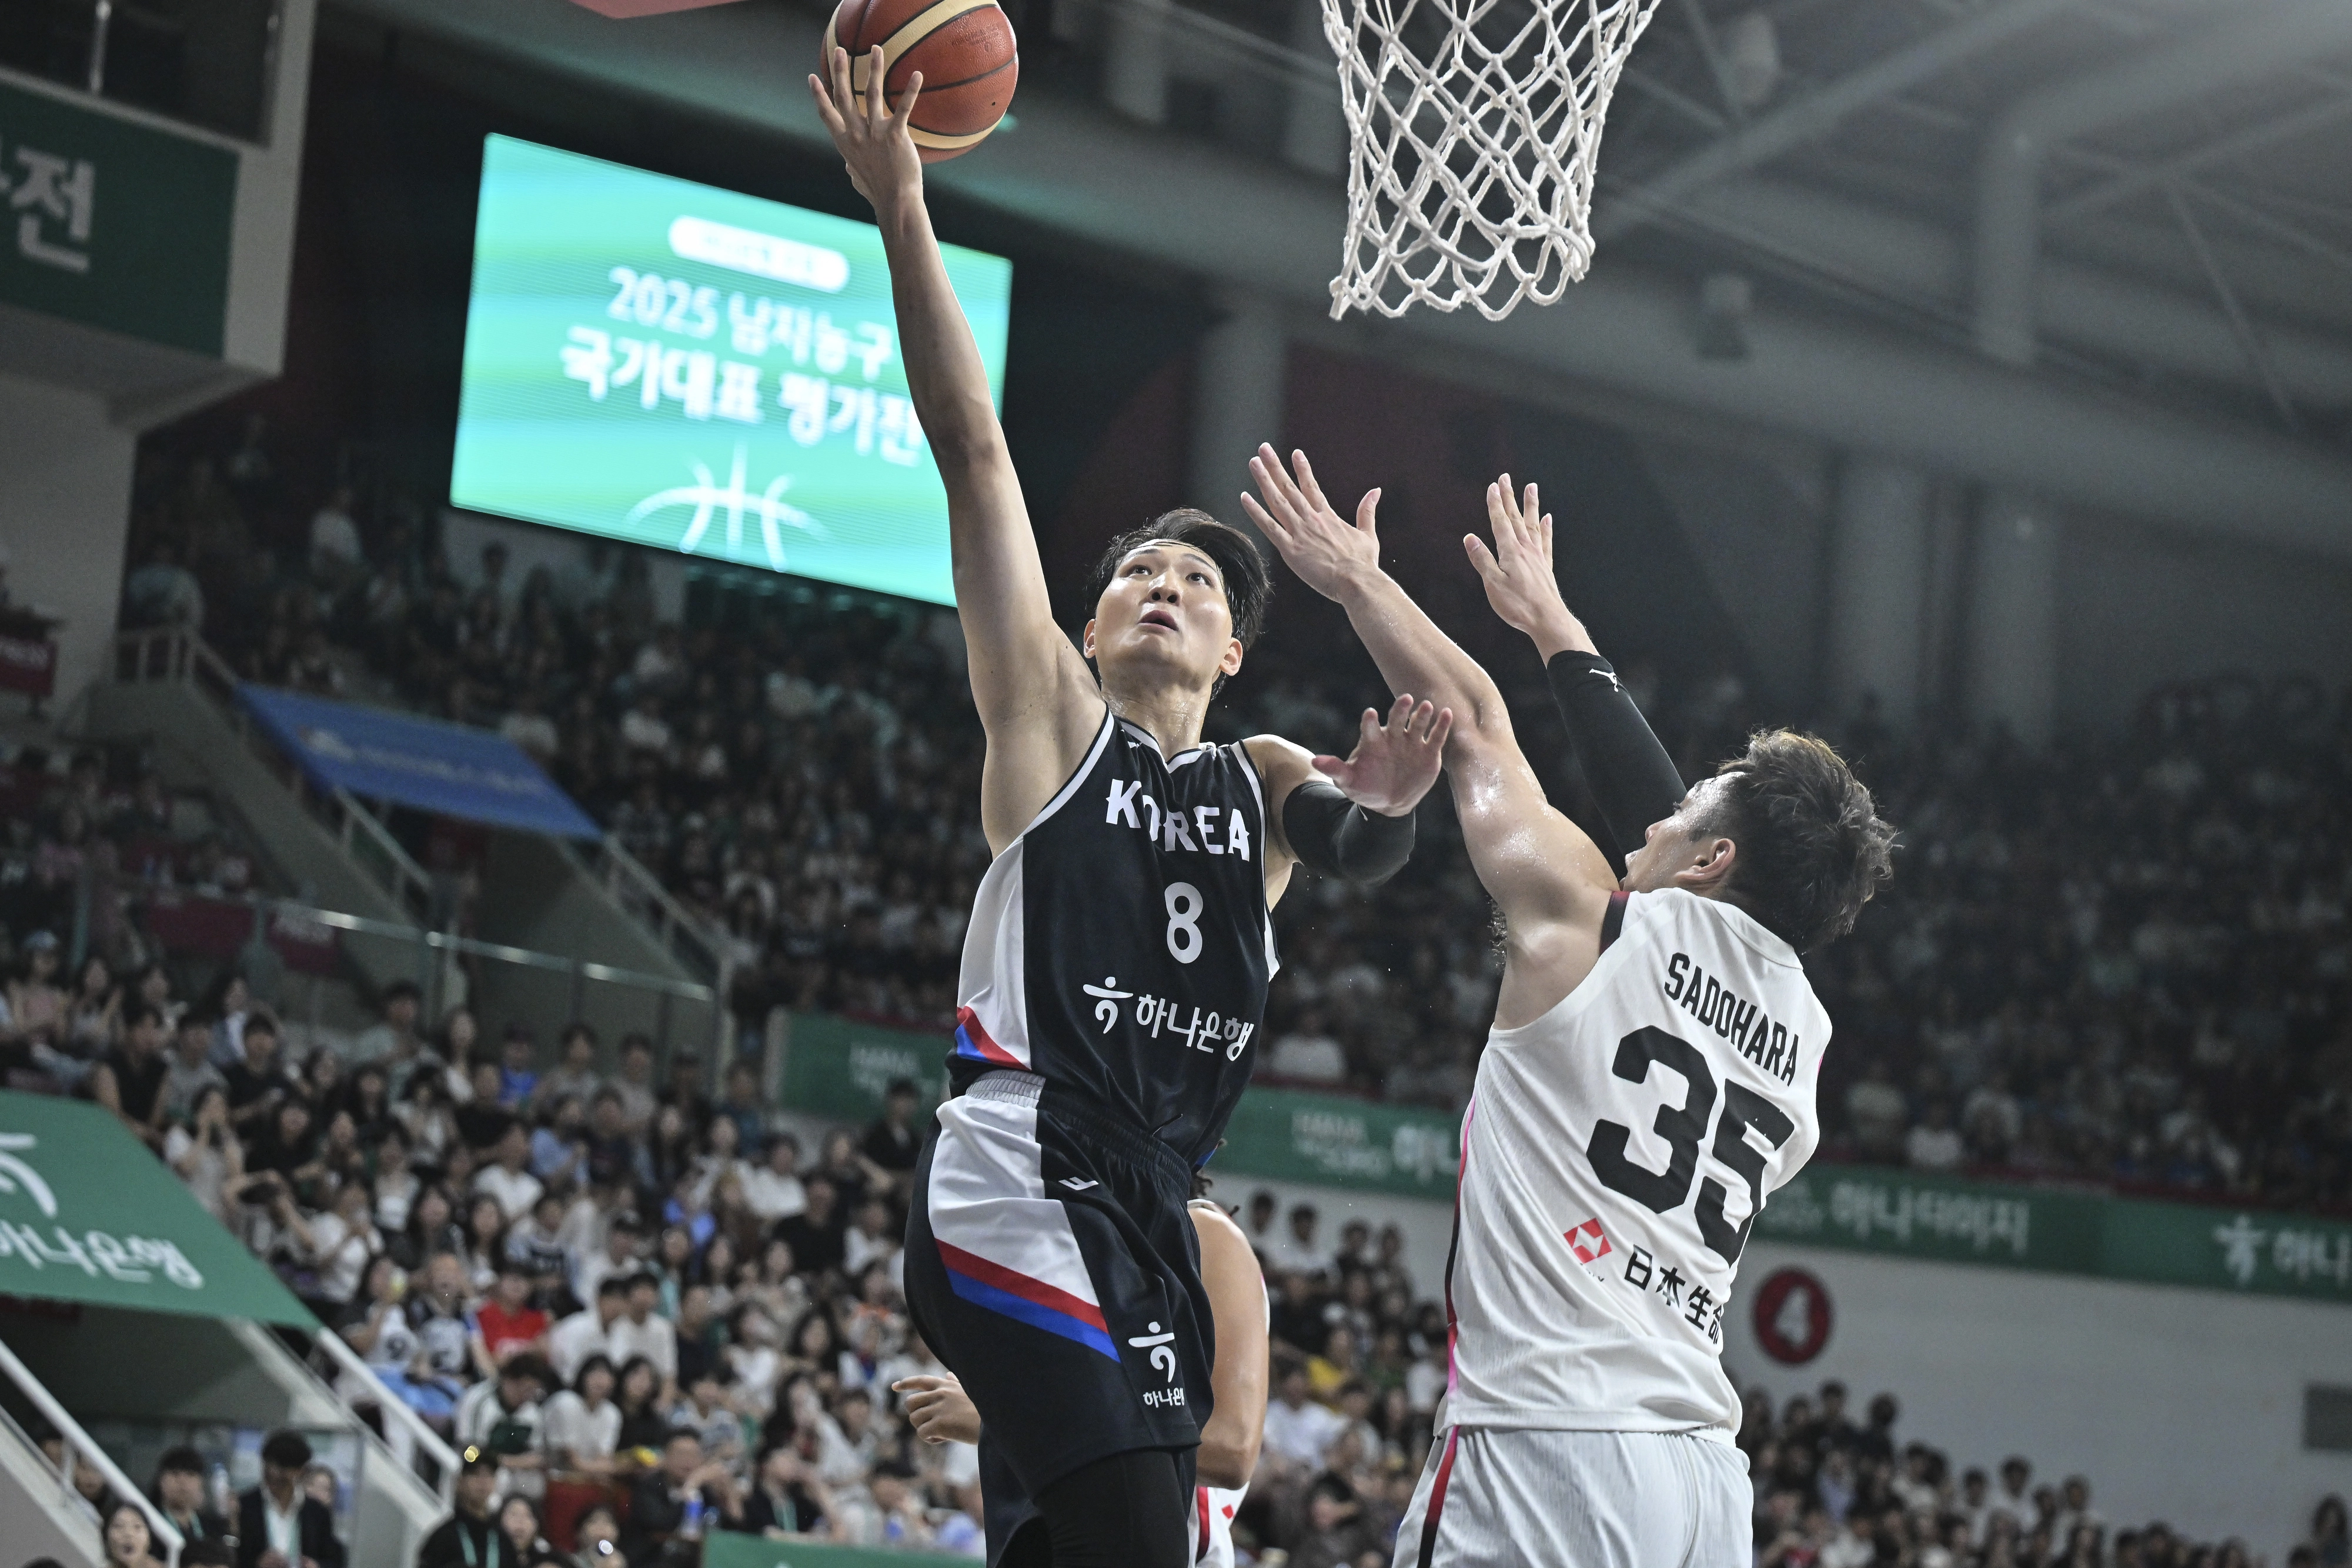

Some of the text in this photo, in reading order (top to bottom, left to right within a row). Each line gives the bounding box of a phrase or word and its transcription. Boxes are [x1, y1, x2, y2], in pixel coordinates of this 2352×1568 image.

[605, 266, 720, 339] 2025
[560, 323, 762, 424] 국가대표
[1164, 882, 1203, 964] 8
[1136, 994, 1254, 1061] 하나은행
[1665, 952, 1800, 1087] SADOHARA
[1586, 1025, 1795, 1270] 35
[1774, 1285, 1813, 1347] 4
